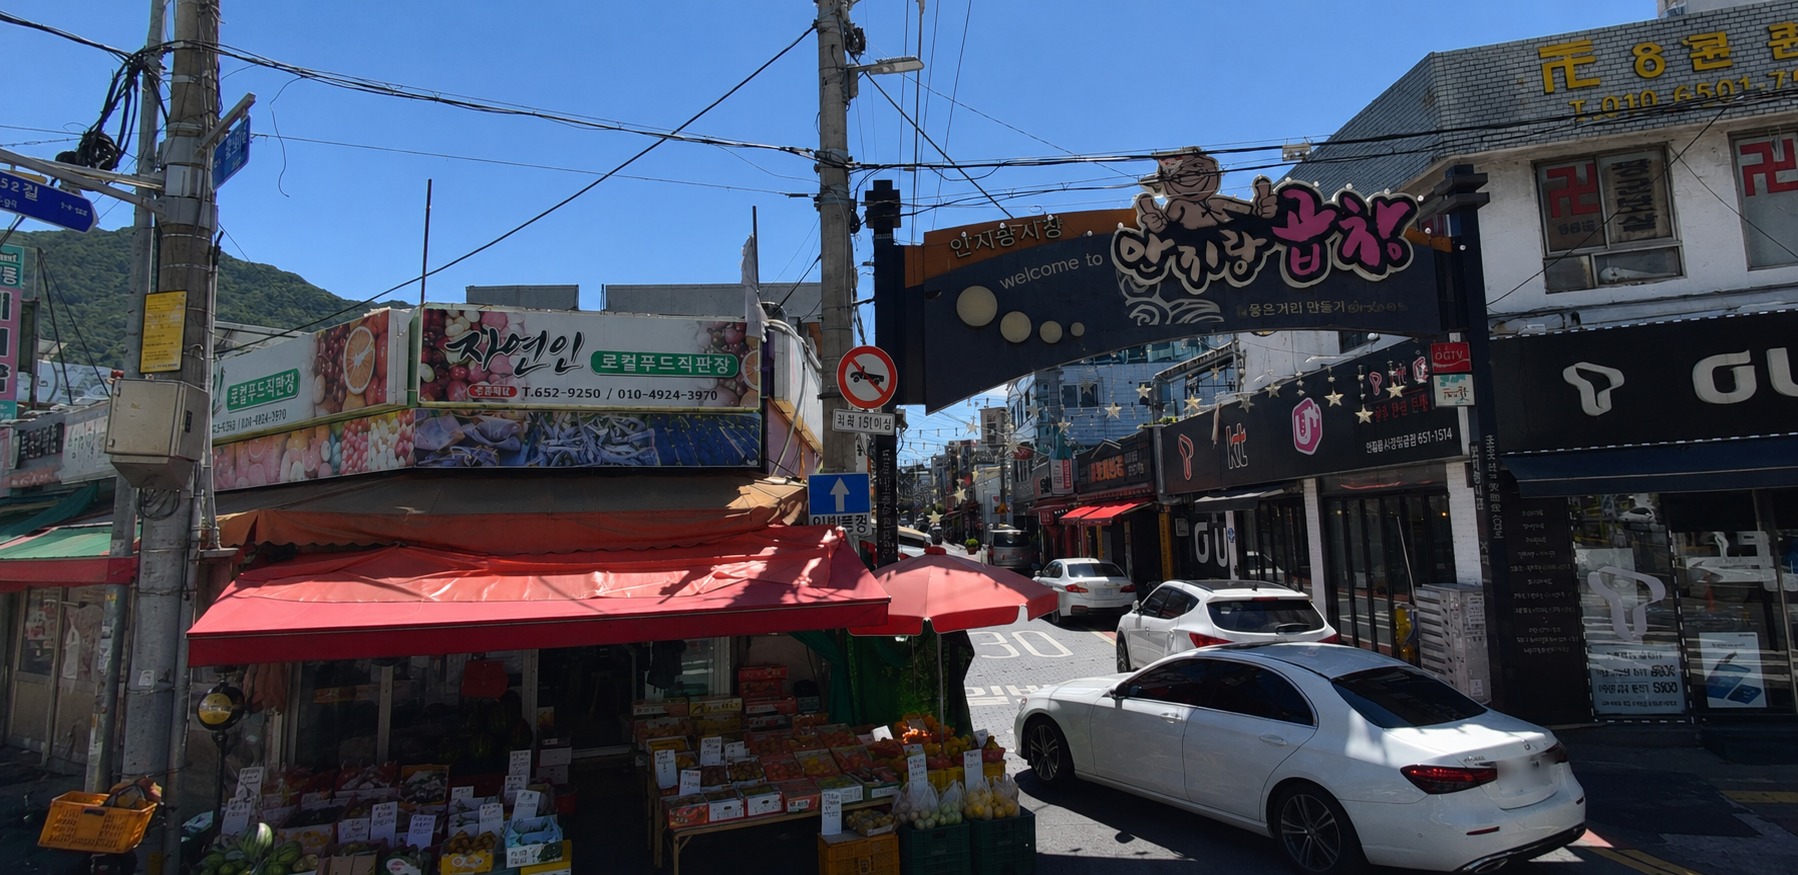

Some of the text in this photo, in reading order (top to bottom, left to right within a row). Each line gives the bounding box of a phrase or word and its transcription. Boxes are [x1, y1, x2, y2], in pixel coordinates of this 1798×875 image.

[1271, 187, 1411, 277] 곱창
[999, 253, 1103, 290] welcome to
[445, 327, 584, 378] 자연인
[600, 353, 732, 374] 로컬푸드직판장
[230, 371, 296, 406] 로컬푸드직판장
[522, 387, 601, 400] T.652-9250
[617, 388, 718, 401] 010-4924-3970
[1225, 422, 1248, 470] kt
[1417, 427, 1453, 445] 651-1514
[968, 630, 1074, 658] 30
